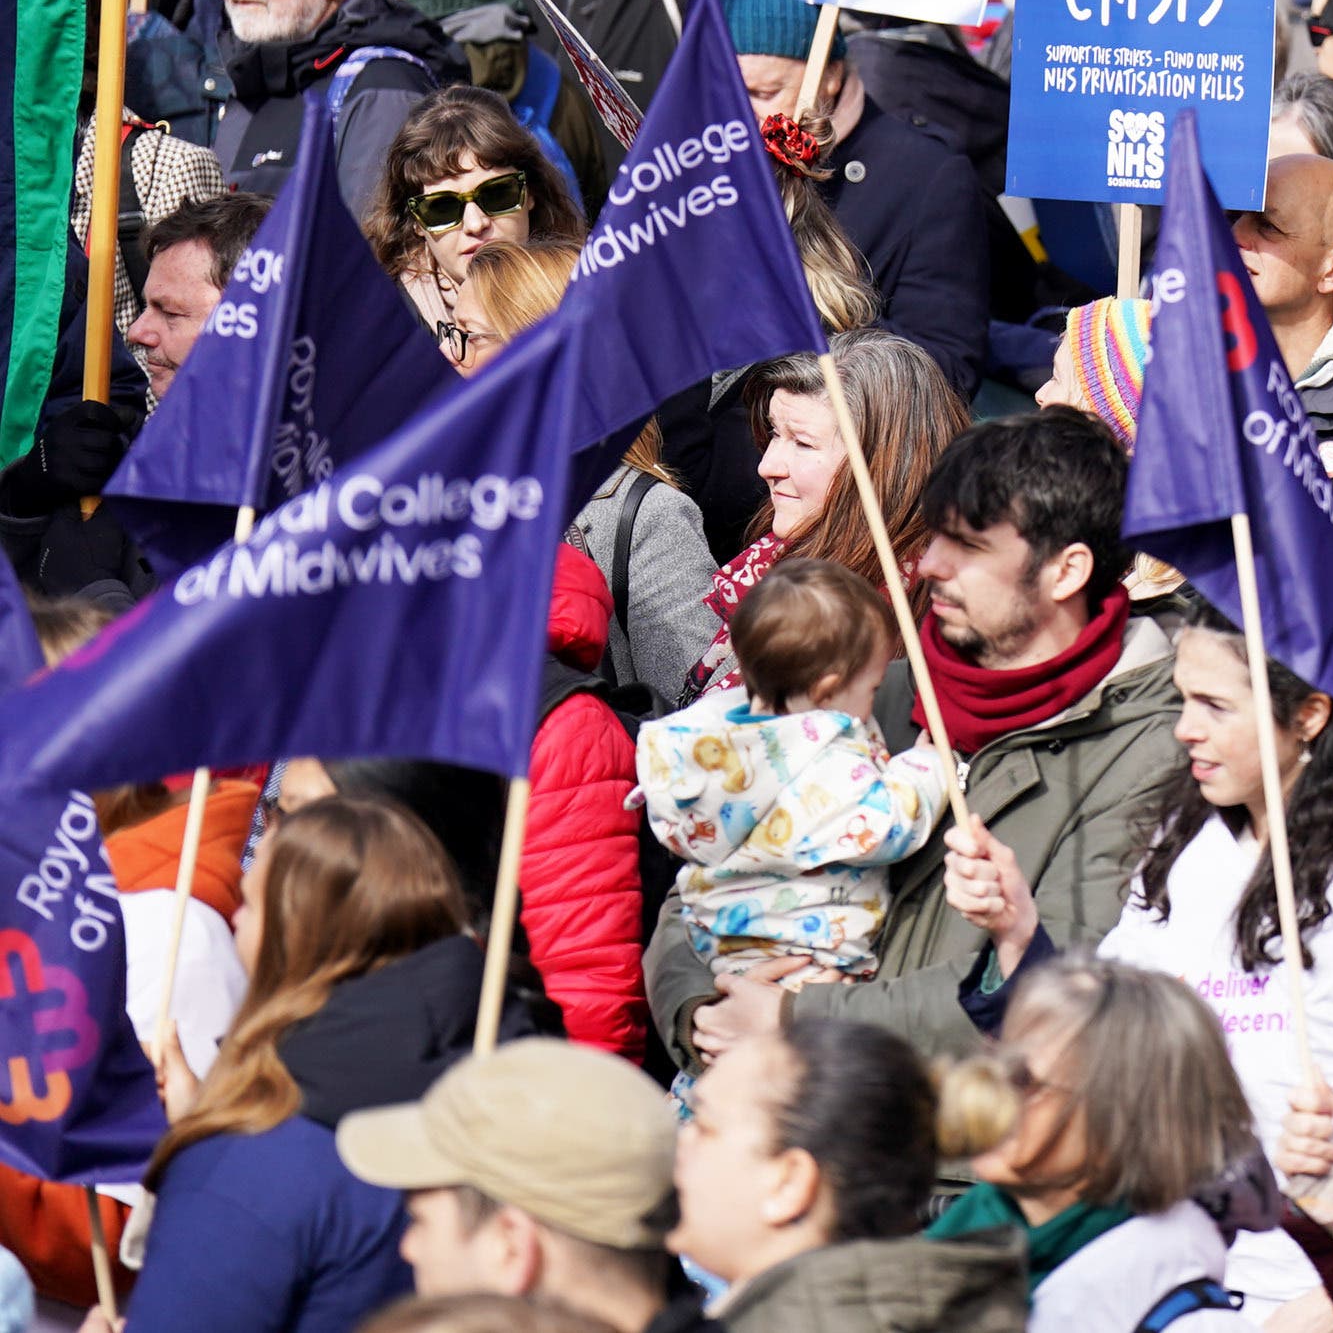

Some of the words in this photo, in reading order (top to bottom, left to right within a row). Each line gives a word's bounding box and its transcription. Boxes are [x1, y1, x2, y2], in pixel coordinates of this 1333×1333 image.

[1045, 44, 1091, 65] SUPPORT
[1092, 45, 1112, 66] THE
[1113, 47, 1154, 68] STRIKES
[1163, 50, 1195, 70] FUND
[1196, 52, 1219, 70] OUR
[1220, 53, 1244, 73] NHS
[1044, 66, 1077, 93] NHS
[1080, 67, 1196, 100] PRIVATISATION
[1201, 72, 1245, 103] KILLS
[1107, 141, 1165, 179] NHS
[338, 473, 544, 532] College
[228, 531, 483, 599] Midwives
[16, 789, 97, 922] Royal
[70, 891, 116, 953] of
[1199, 971, 1271, 999] deliver
